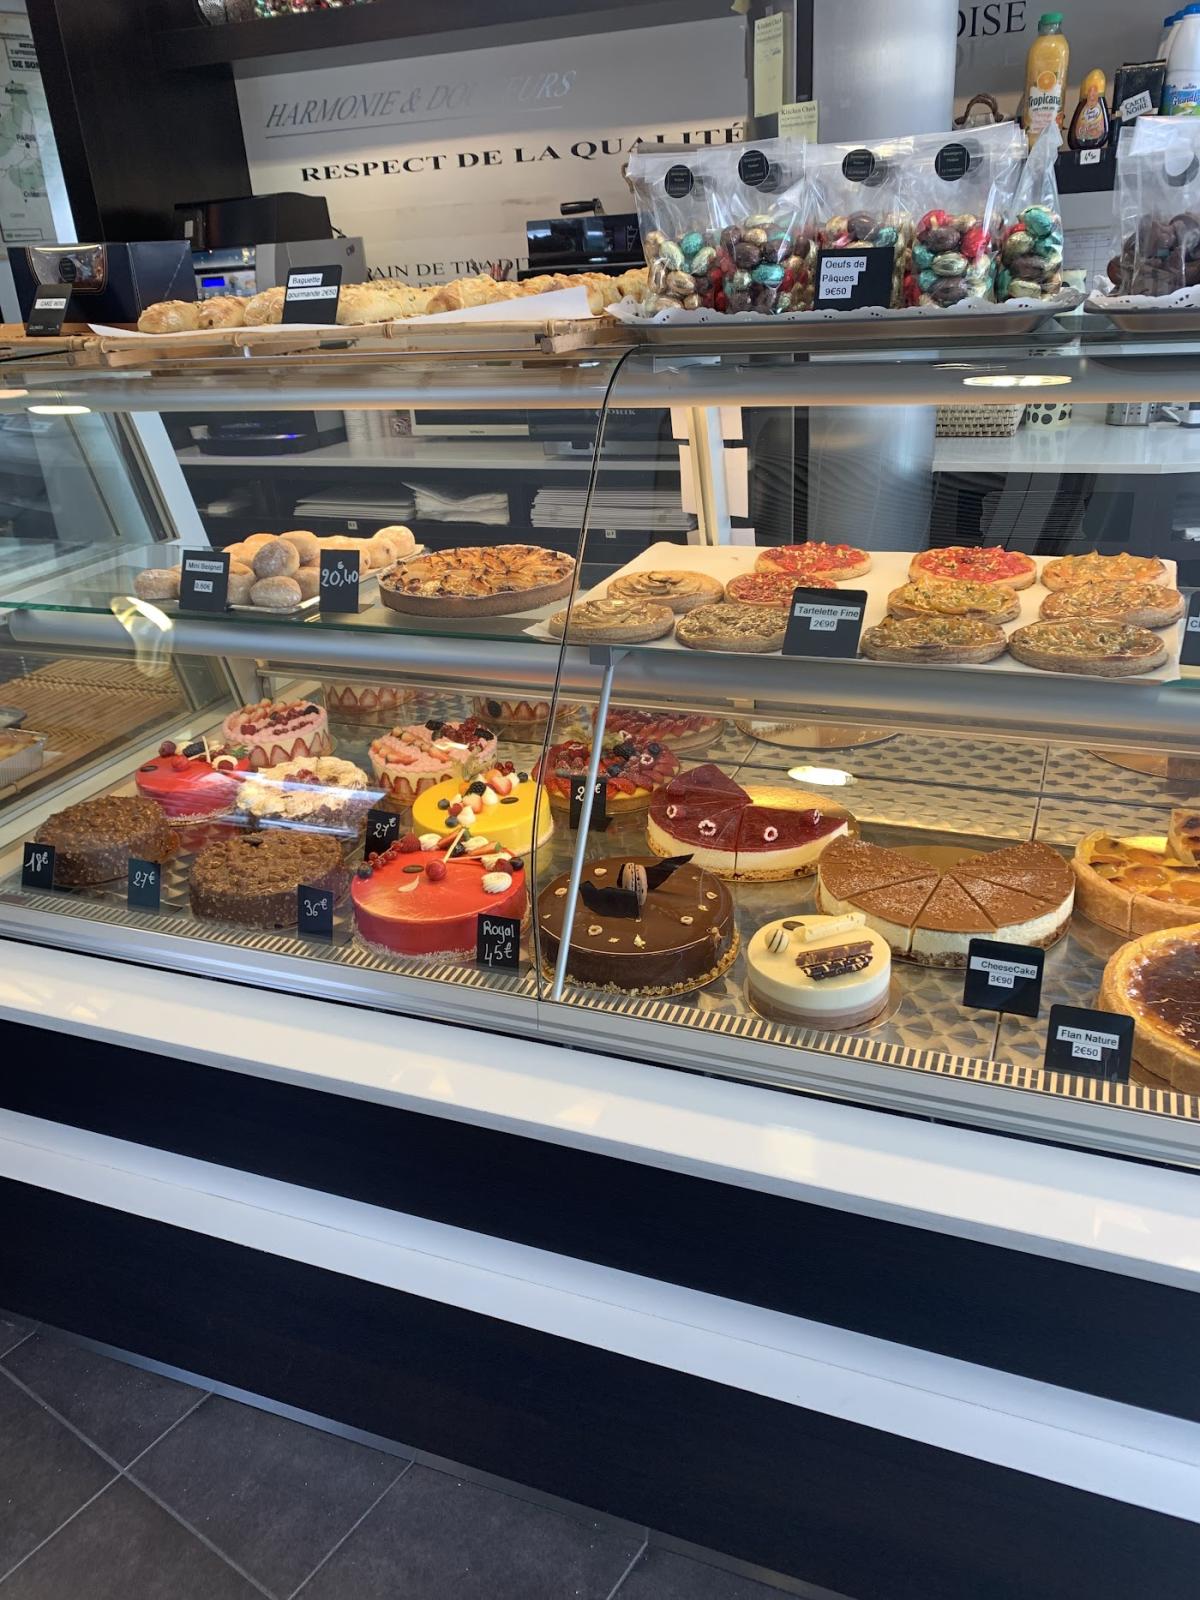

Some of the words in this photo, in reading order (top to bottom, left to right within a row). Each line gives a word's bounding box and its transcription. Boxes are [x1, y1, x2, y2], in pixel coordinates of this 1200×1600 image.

[265, 89, 401, 128] HARMONIE
[400, 86, 420, 114] &
[425, 70, 577, 111] DOEURS
[1028, 93, 1061, 107] Tropicana
[1125, 96, 1147, 109] CARTE
[1126, 102, 1149, 115] NOIRE
[301, 154, 447, 182] RESPECT
[458, 150, 502, 168] DE
[515, 145, 562, 164] LA
[416, 262, 445, 277] DE
[825, 260, 852, 269] Oeufs
[853, 260, 865, 269] de
[292, 276, 321, 286] Baguette
[822, 274, 855, 284] Pâques
[825, 287, 847, 296] 9€50
[321, 568, 359, 587] 20,40
[799, 606, 839, 617] Tartelette
[840, 608, 859, 618] Fine
[813, 620, 835, 628] 2€90
[575, 783, 602, 802] 2€
[25, 851, 49, 872] 18€
[133, 871, 156, 888] 27€
[483, 920, 515, 944] Royal
[484, 942, 513, 967] 45€
[981, 960, 1036, 976] CheeseCake
[990, 975, 1013, 985] 3€90
[1061, 1029, 1082, 1040] Flan
[1085, 1033, 1117, 1047] Nature
[1074, 1045, 1099, 1057] 2€50
